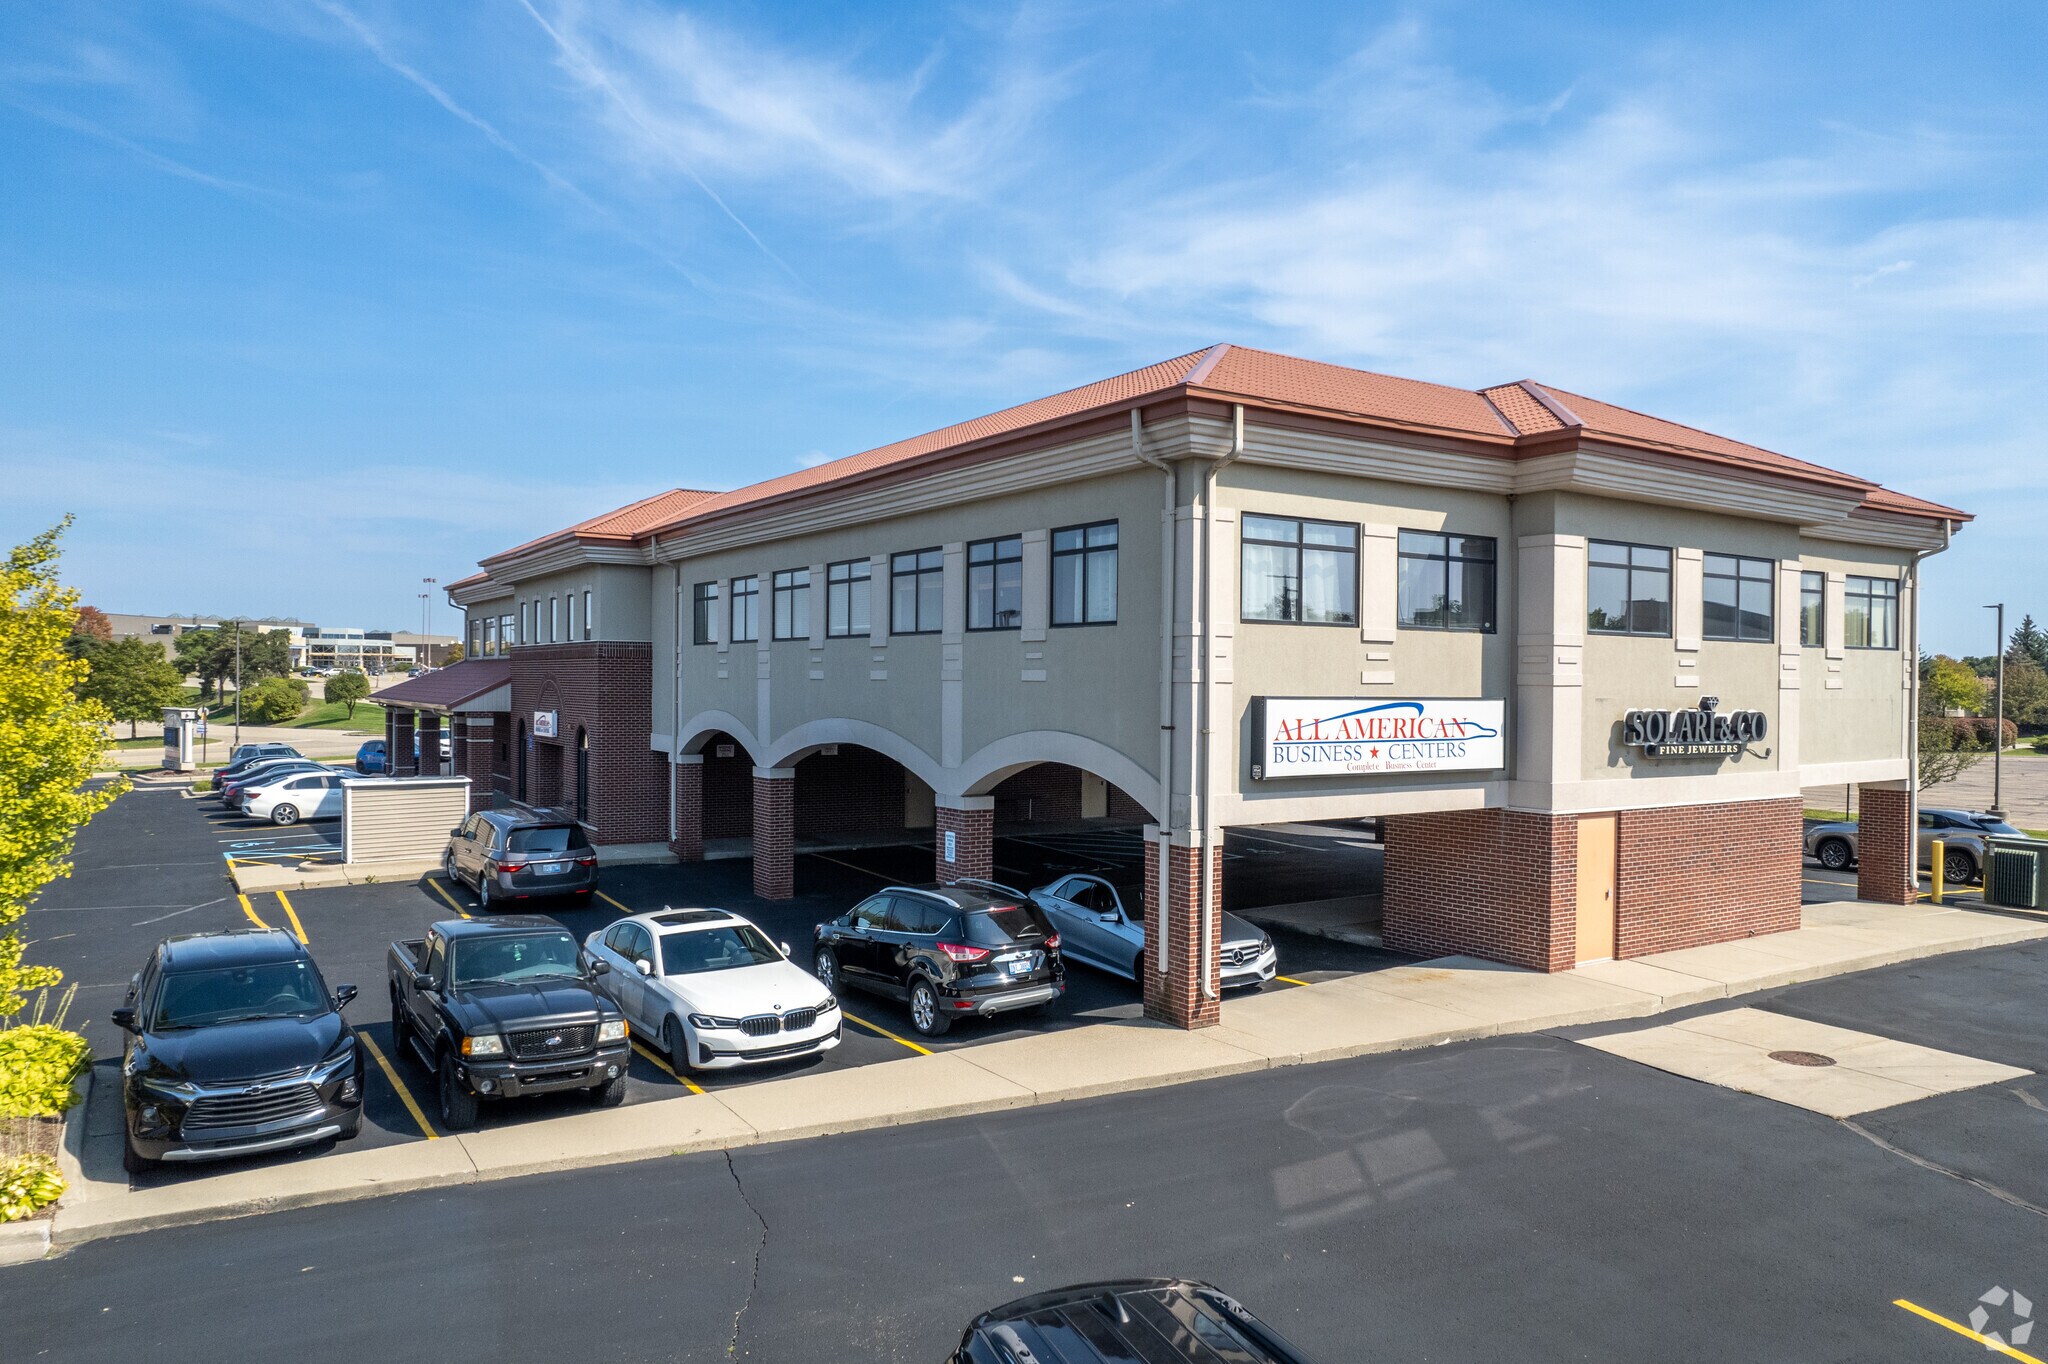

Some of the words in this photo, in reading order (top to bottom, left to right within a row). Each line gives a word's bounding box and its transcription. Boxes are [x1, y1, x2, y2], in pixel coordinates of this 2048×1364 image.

[1273, 718, 1330, 741] ALL
[1335, 717, 1468, 740] AMERICAN
[1273, 745, 1362, 764] BUSINESS
[1388, 742, 1467, 760] CENTERS
[1659, 745, 1685, 755] FINE
[1687, 744, 1738, 754] JEWELERS
[1346, 761, 1380, 772] Complete
[1385, 760, 1413, 770] Business
[1416, 759, 1437, 769] Center
